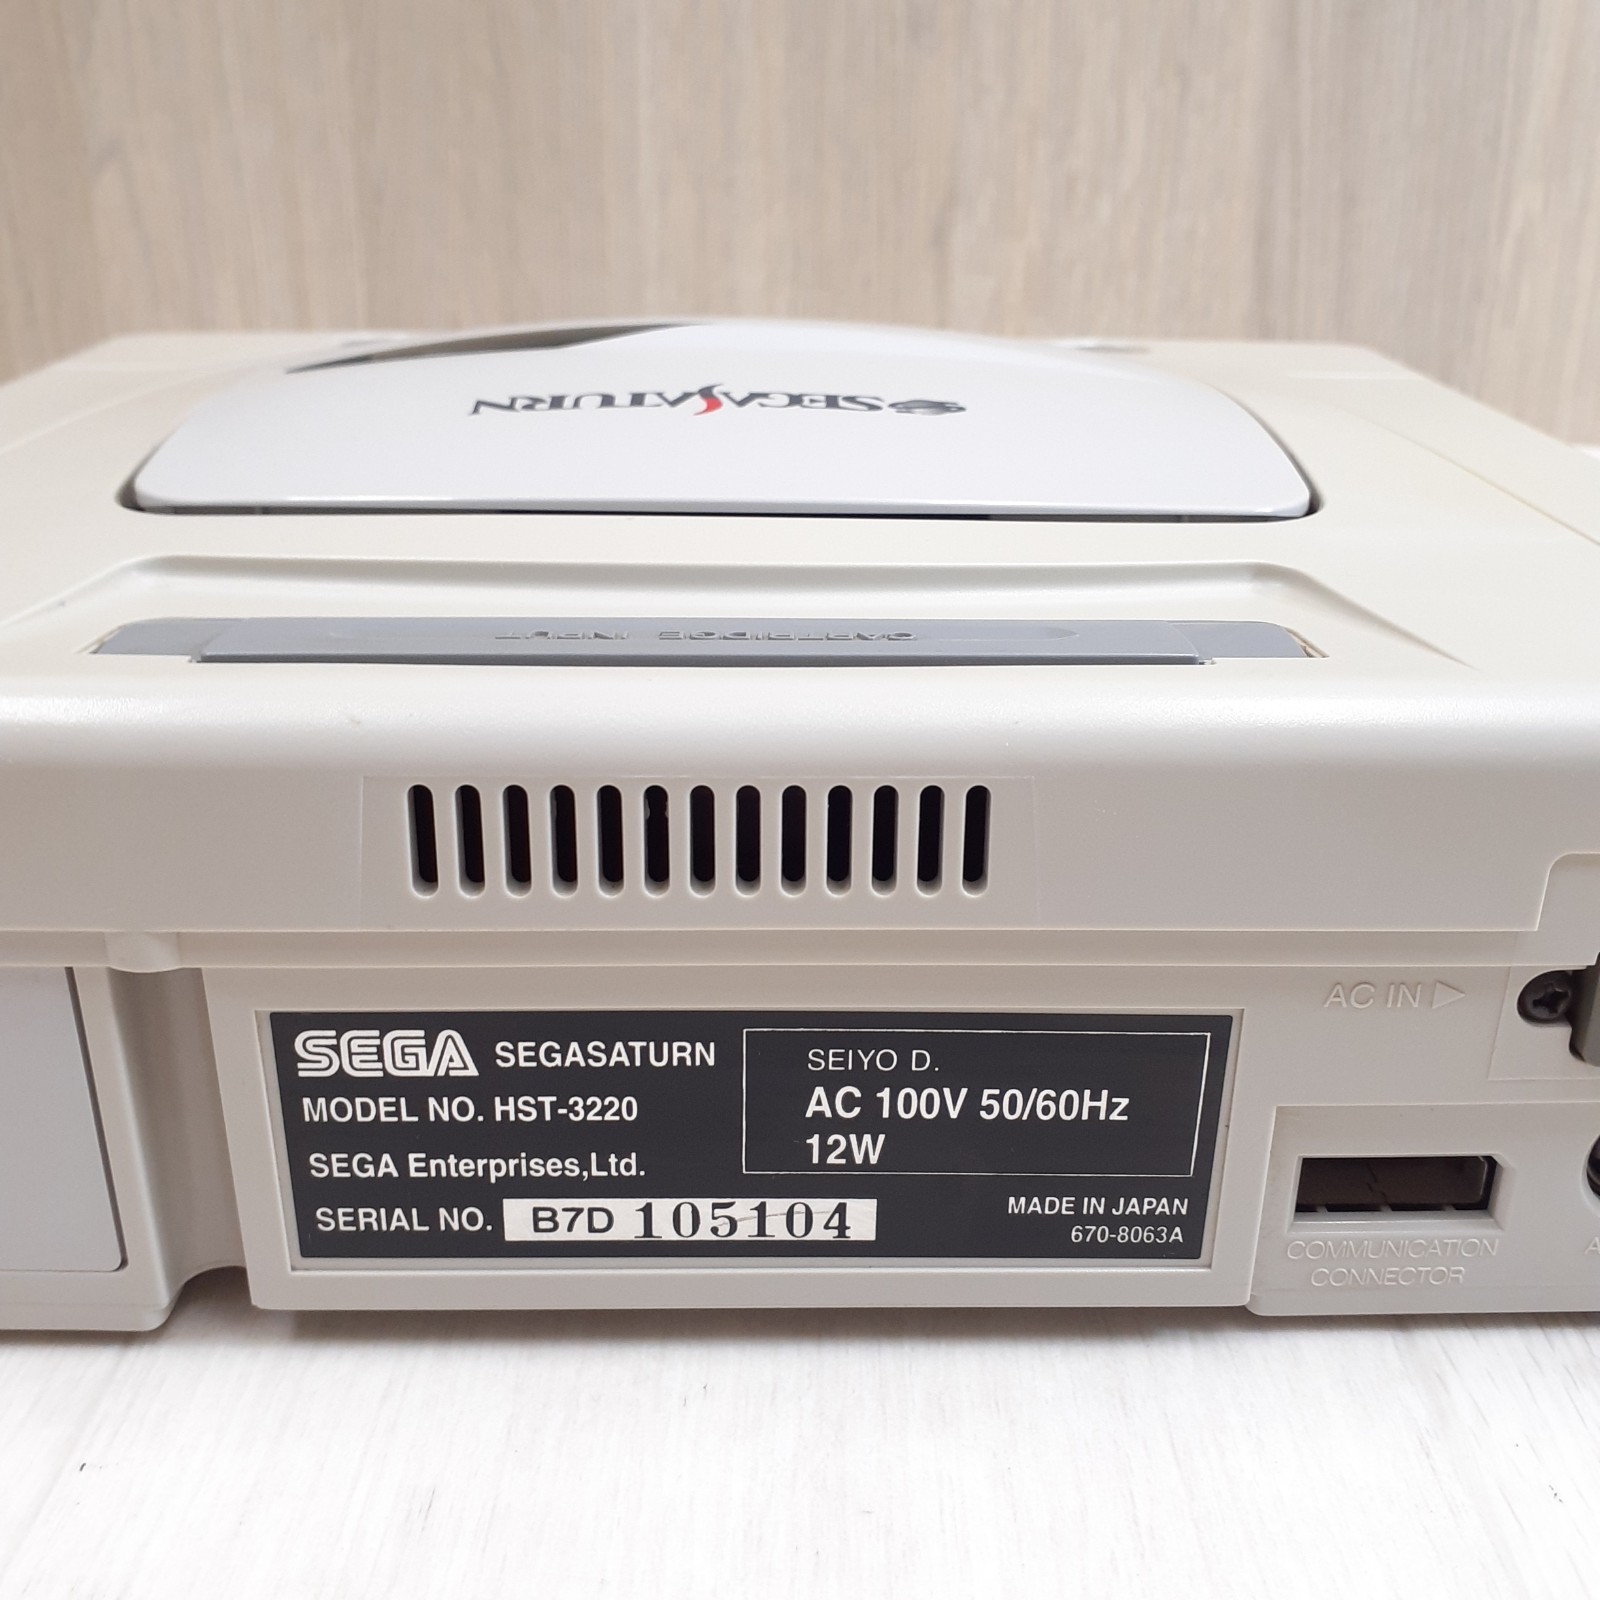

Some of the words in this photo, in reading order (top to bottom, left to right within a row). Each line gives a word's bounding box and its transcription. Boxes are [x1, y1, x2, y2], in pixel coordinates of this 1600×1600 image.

[469, 384, 886, 416] SEGASATURN
[495, 630, 630, 641] INPUT
[658, 630, 918, 641] CARTRIDGE
[1324, 983, 1374, 1009] AC
[1387, 984, 1422, 1008] IN
[294, 1029, 479, 1077] SEGA
[494, 1041, 716, 1068] SEGASATURN
[807, 1049, 898, 1072] SEIYO
[911, 1050, 940, 1071] D.
[302, 1097, 419, 1123] MODEL
[428, 1097, 484, 1122] NO.
[494, 1096, 639, 1122] HST-3220
[805, 1086, 862, 1119] AC
[876, 1087, 968, 1119] 100V
[979, 1088, 1130, 1121] 50/60Hz
[806, 1134, 886, 1165] 12W
[309, 1153, 400, 1178] SEGA
[408, 1152, 646, 1183] Enterprises,Ltd.
[1008, 1196, 1075, 1216] MADE
[1082, 1197, 1103, 1216] IN
[1111, 1197, 1188, 1216] JAPAN
[315, 1207, 430, 1232] SERIAL
[439, 1206, 493, 1232] NO.
[532, 1207, 615, 1234] B7D
[634, 1201, 851, 1239] 105104
[1070, 1225, 1184, 1244] 670-8063A
[1286, 1238, 1500, 1260] COMMUNICATION
[1310, 1266, 1466, 1287] CONNECTOR
